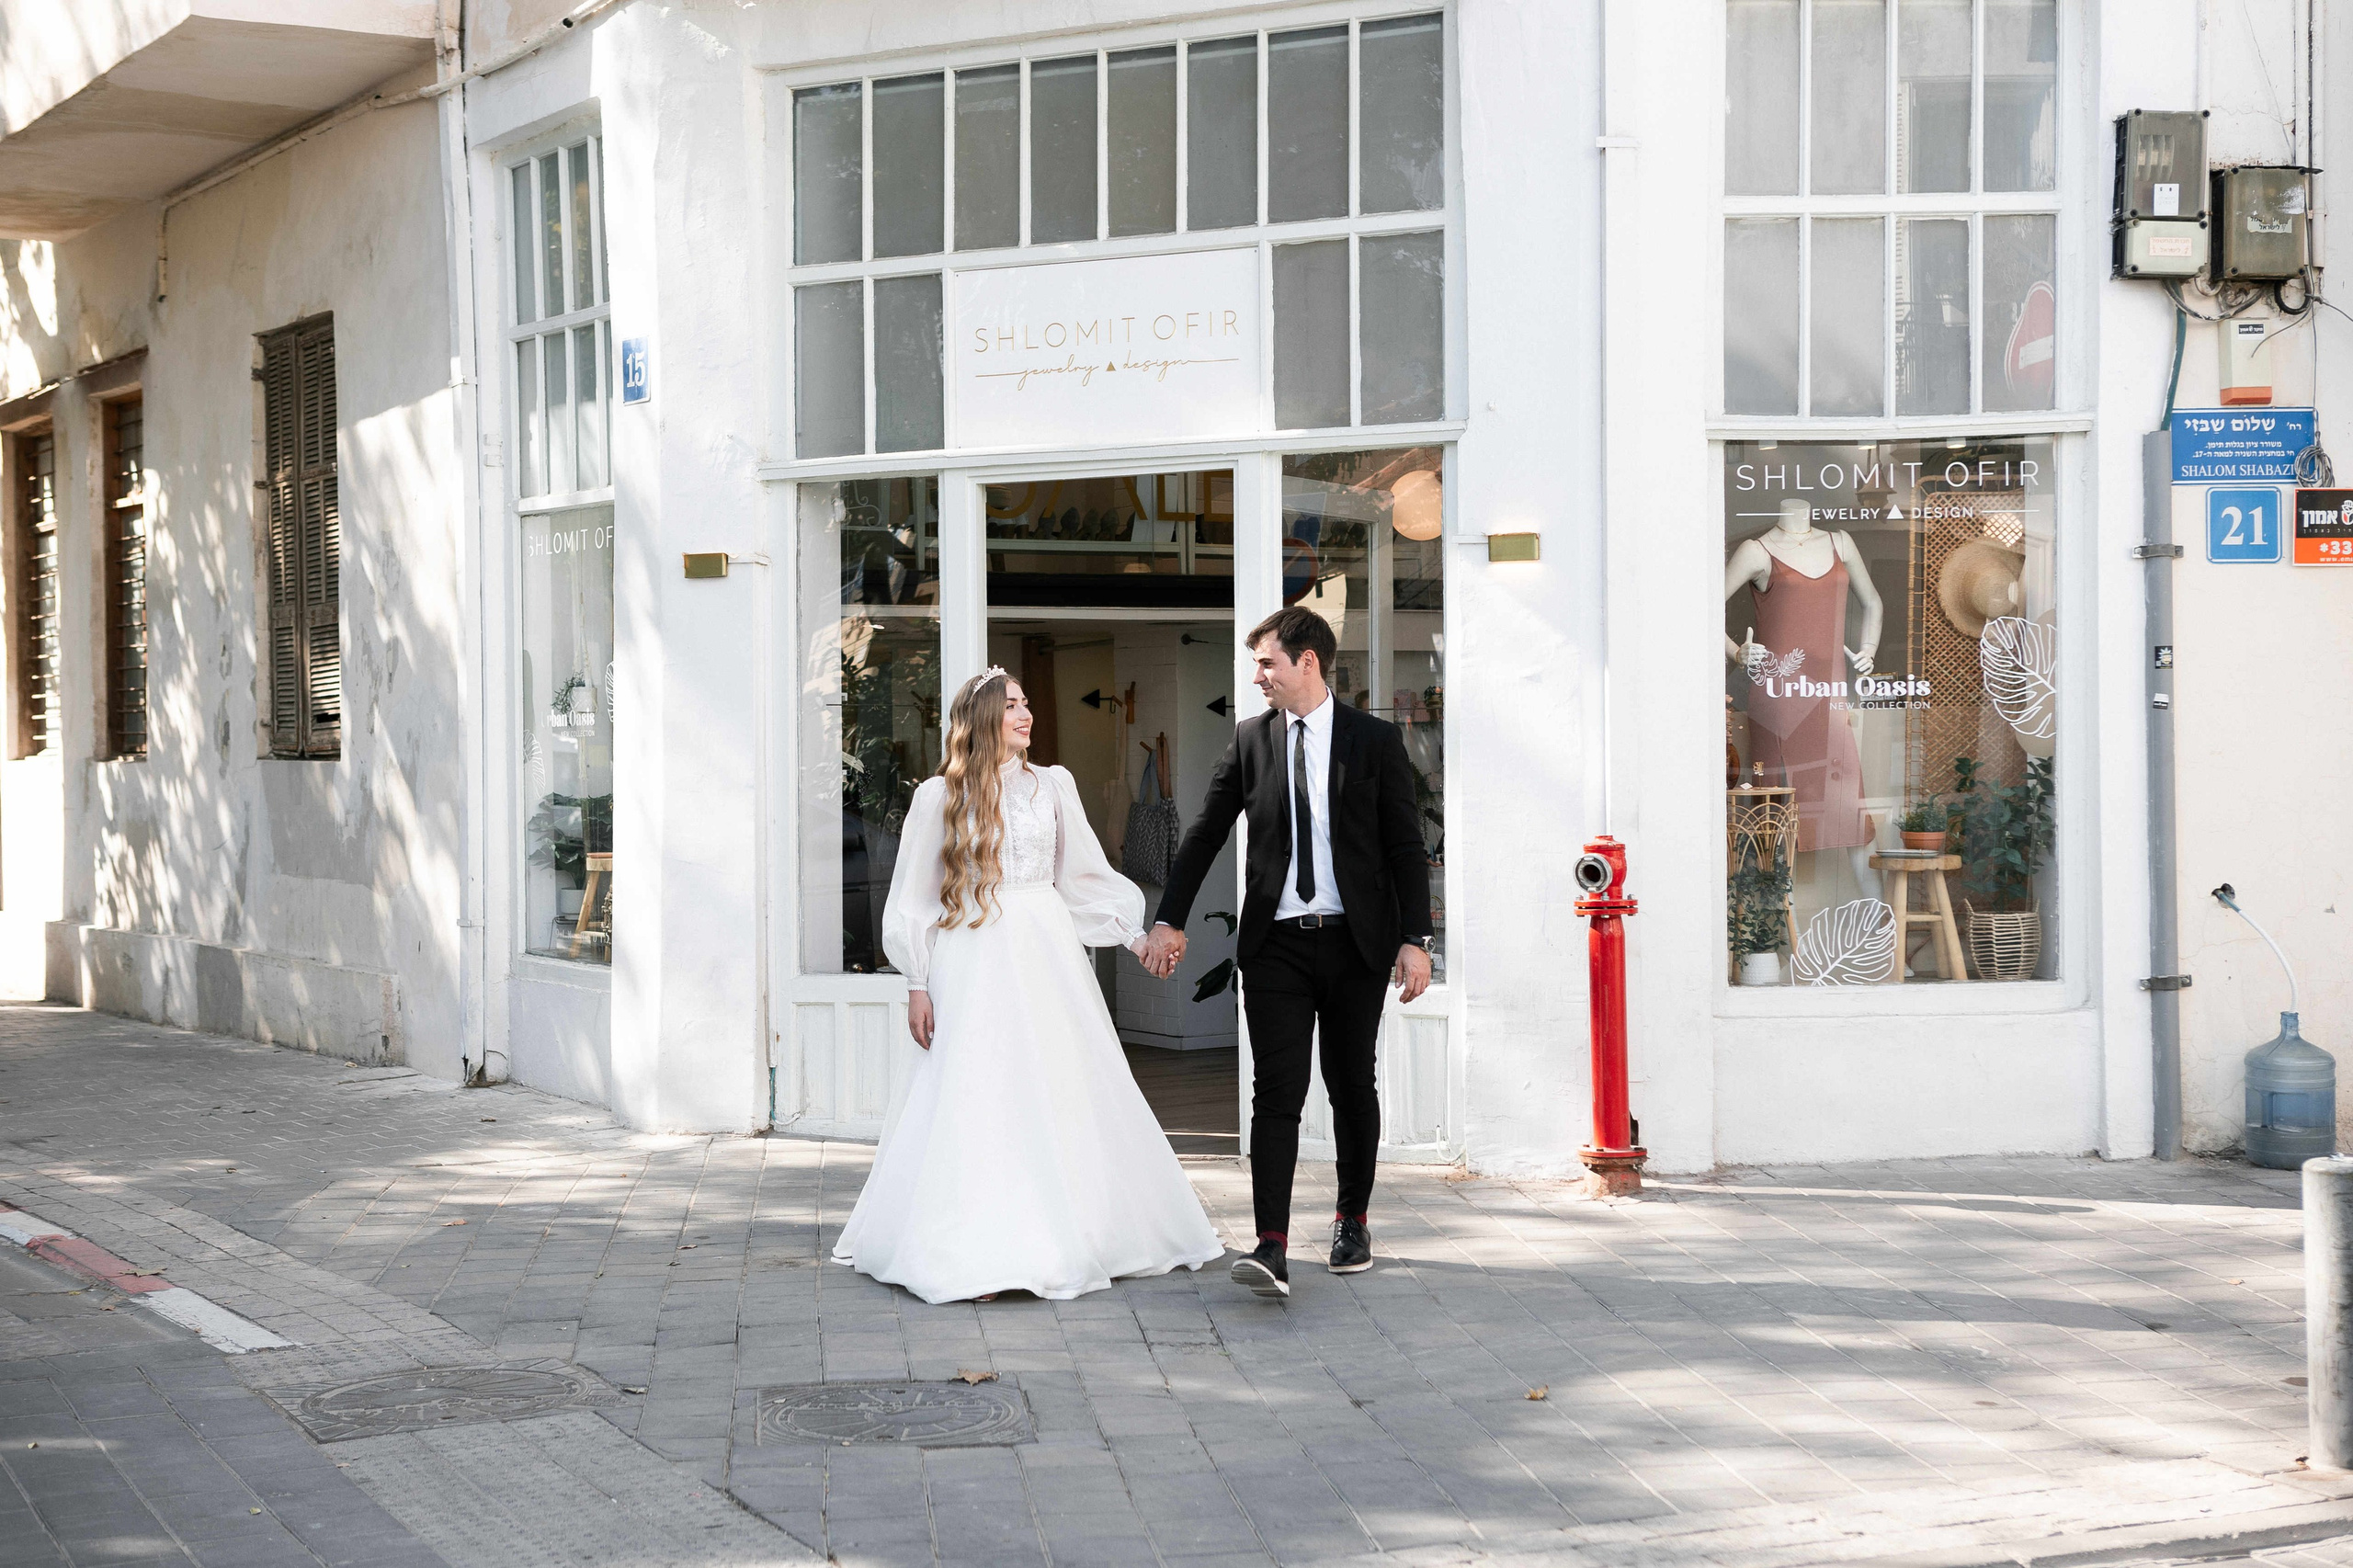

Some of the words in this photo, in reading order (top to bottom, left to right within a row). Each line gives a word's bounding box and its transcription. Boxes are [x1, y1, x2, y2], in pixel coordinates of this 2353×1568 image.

[974, 318, 1135, 352] SHLOMIT
[1153, 310, 1239, 340] OFIR
[626, 351, 646, 388] 15
[1016, 353, 1099, 391] jewelry
[1122, 349, 1192, 381] design
[2213, 449, 2234, 458] למאה
[2245, 441, 2259, 449] ציון
[1736, 461, 1923, 491] SHLOMIT
[1945, 460, 2040, 488] OFIR
[2181, 464, 2236, 477] SHALOM
[2239, 463, 2295, 476] SHABAZI
[1803, 507, 1881, 521] JEWELRY
[1912, 506, 1973, 519] DESIGN
[2302, 510, 2338, 528] אמון
[2221, 506, 2268, 545] 21
[529, 528, 588, 557] SHLOMIT
[1766, 675, 1847, 699] Urban
[1854, 674, 1930, 698] Oasis
[1829, 701, 1855, 710] NEW
[1859, 700, 1930, 710] COLLECTION
[570, 708, 596, 726] Oasis
